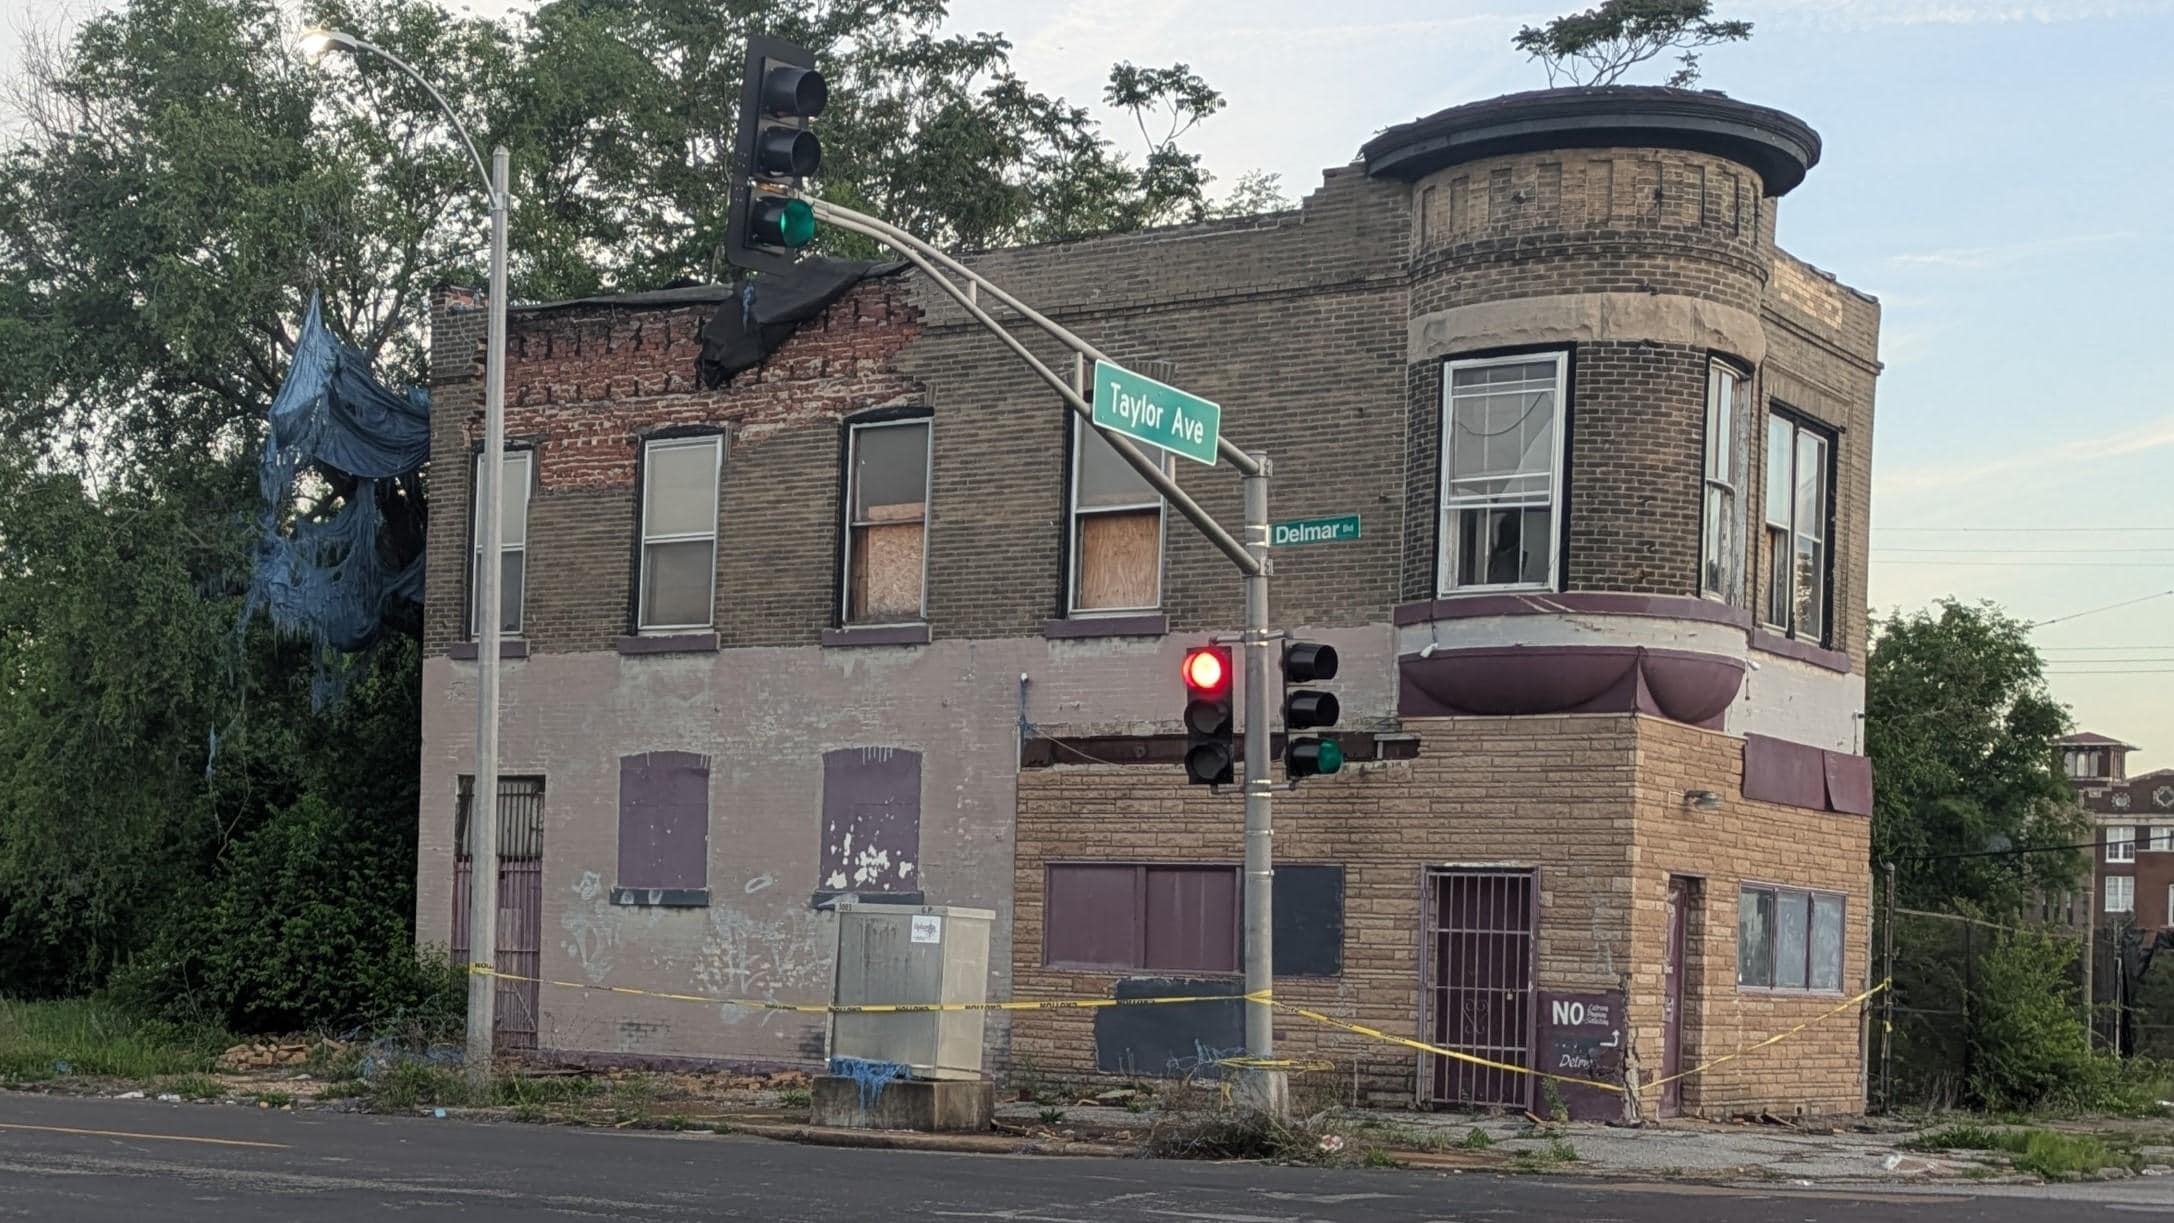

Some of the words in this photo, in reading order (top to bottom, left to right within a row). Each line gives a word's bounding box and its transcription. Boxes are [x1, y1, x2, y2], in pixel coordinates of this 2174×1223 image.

[1111, 382, 1164, 429] Taylor
[1171, 407, 1204, 444] Ave
[1276, 524, 1340, 544] Delmar
[1552, 1000, 1585, 1026] NO
